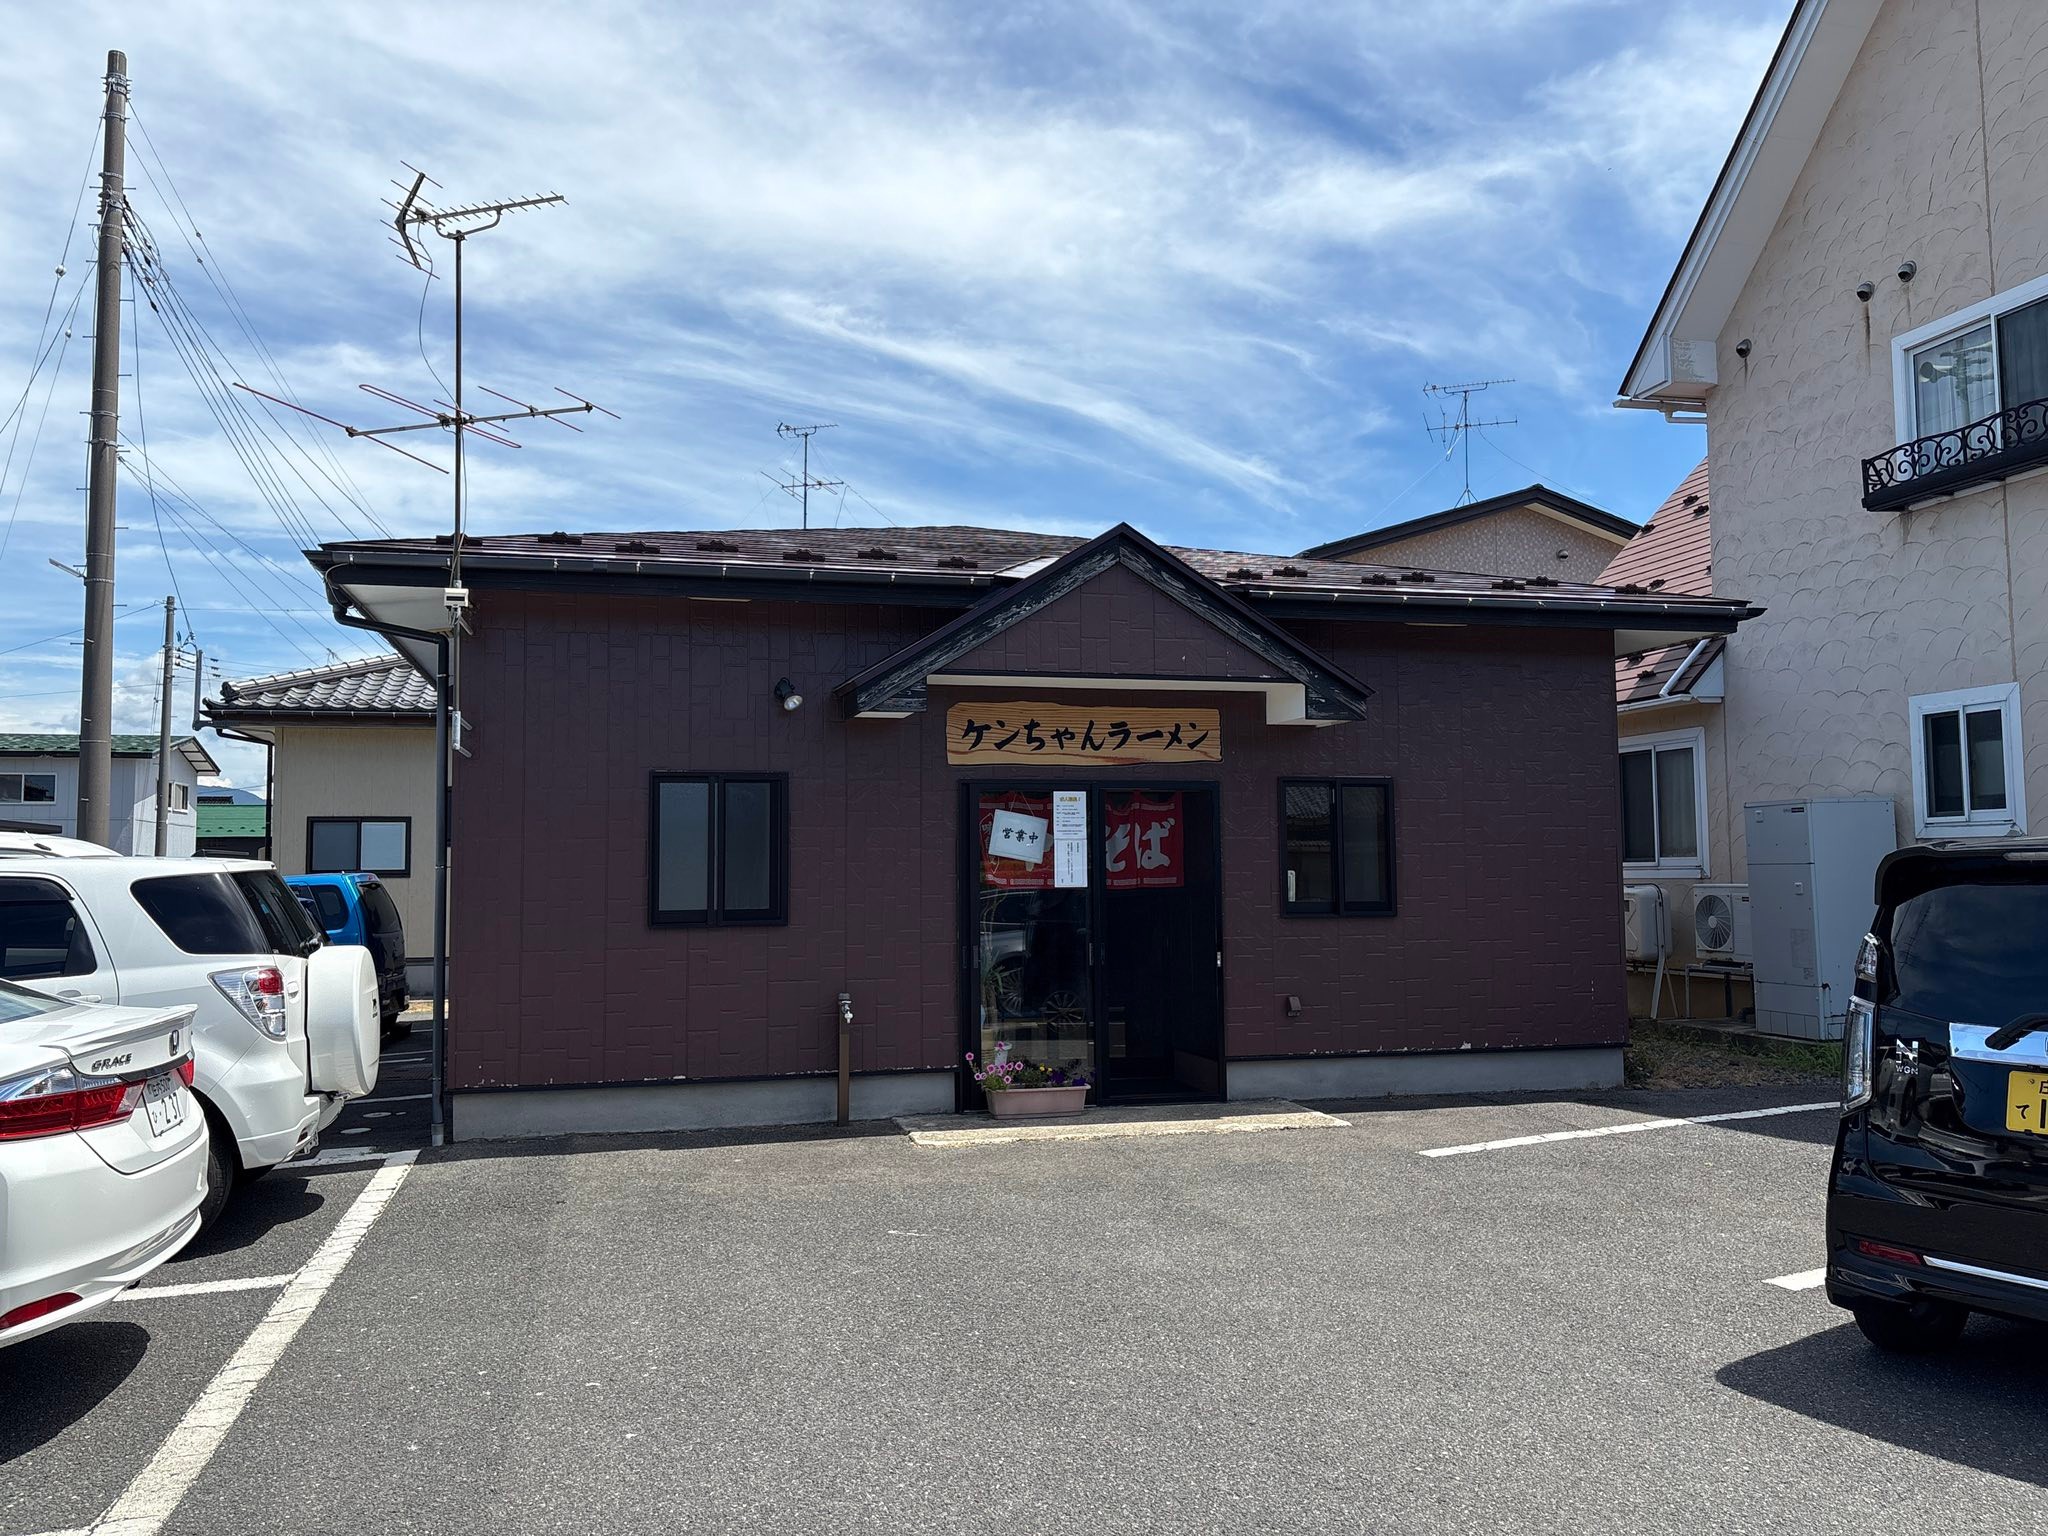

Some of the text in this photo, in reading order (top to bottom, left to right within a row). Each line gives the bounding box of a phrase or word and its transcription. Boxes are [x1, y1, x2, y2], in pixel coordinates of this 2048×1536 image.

[962, 718, 1209, 751] ケンちゃんラーメン
[1002, 827, 1039, 844] 営業中
[91, 1053, 132, 1072] GRACE
